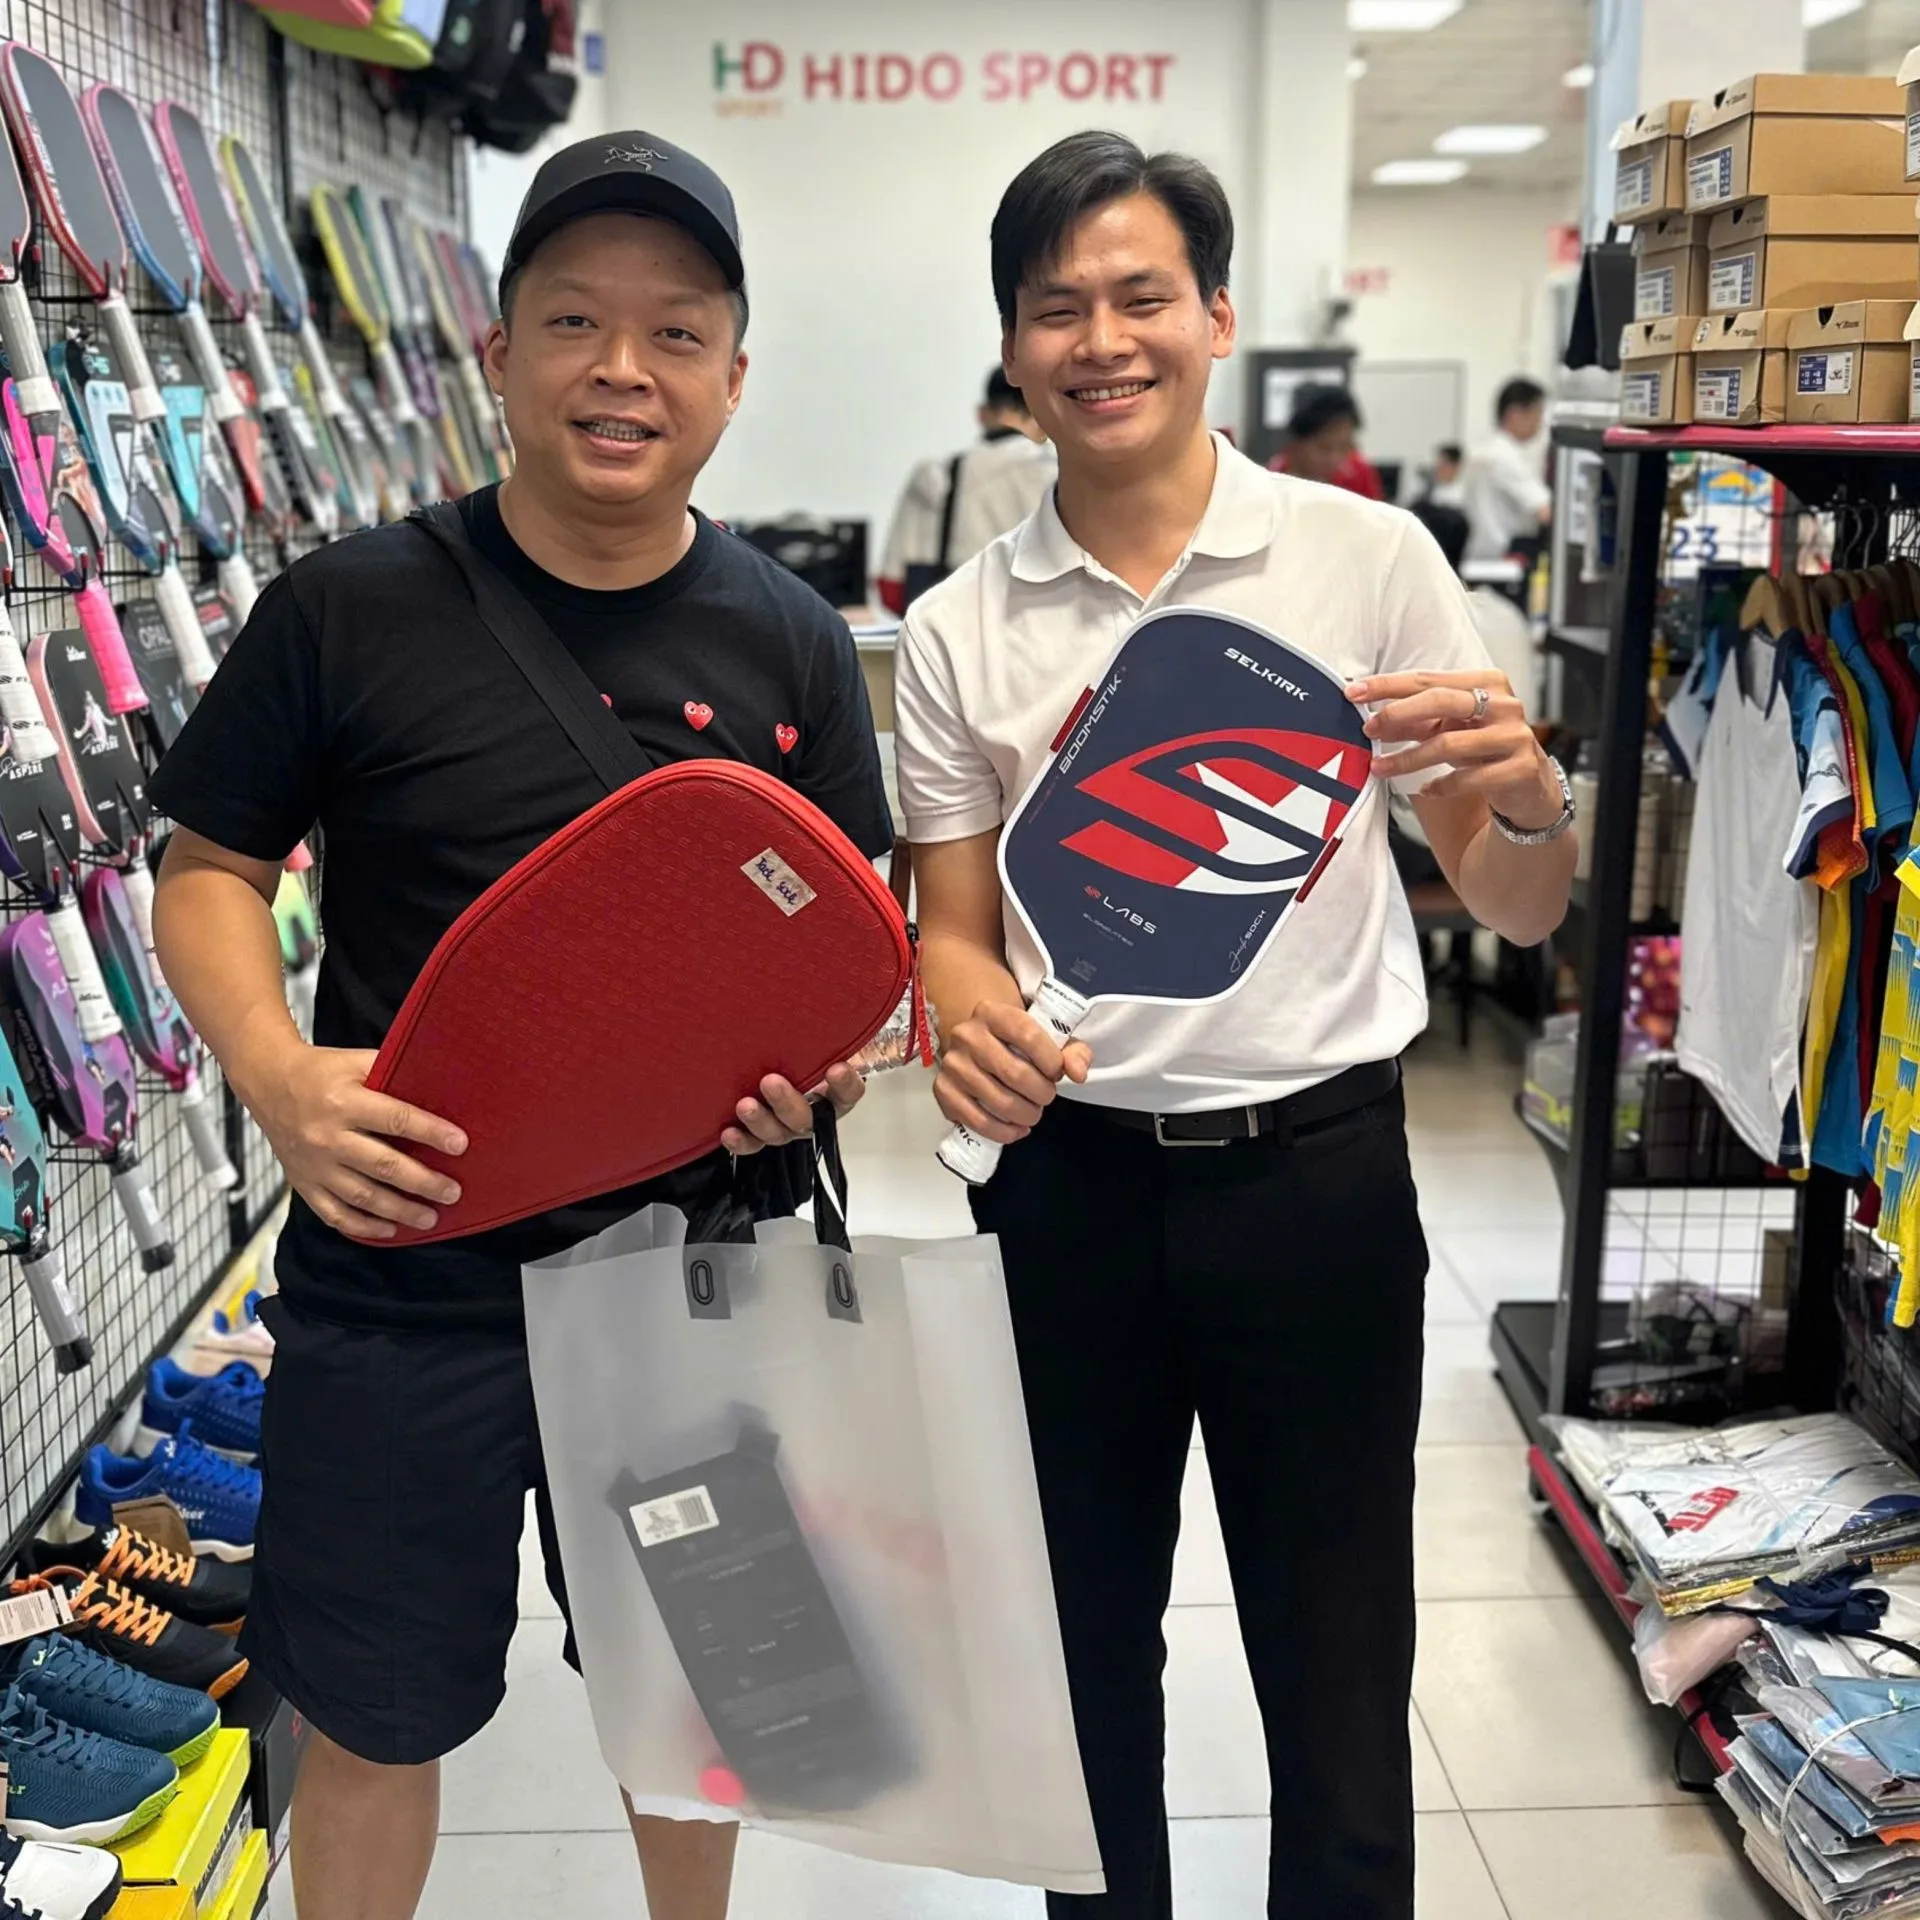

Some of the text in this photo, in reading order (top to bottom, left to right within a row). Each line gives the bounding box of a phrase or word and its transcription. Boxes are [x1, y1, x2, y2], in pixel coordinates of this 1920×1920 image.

[712, 41, 1176, 102] HD HIDO SPORT
[1668, 526, 1719, 561] 23
[1223, 647, 1310, 702] SELKIRK
[1058, 673, 1122, 775] BOOMSTIK
[9, 761, 44, 780] ASPIRE
[1102, 895, 1158, 935] LABS
[1244, 909, 1267, 940] SOCK
